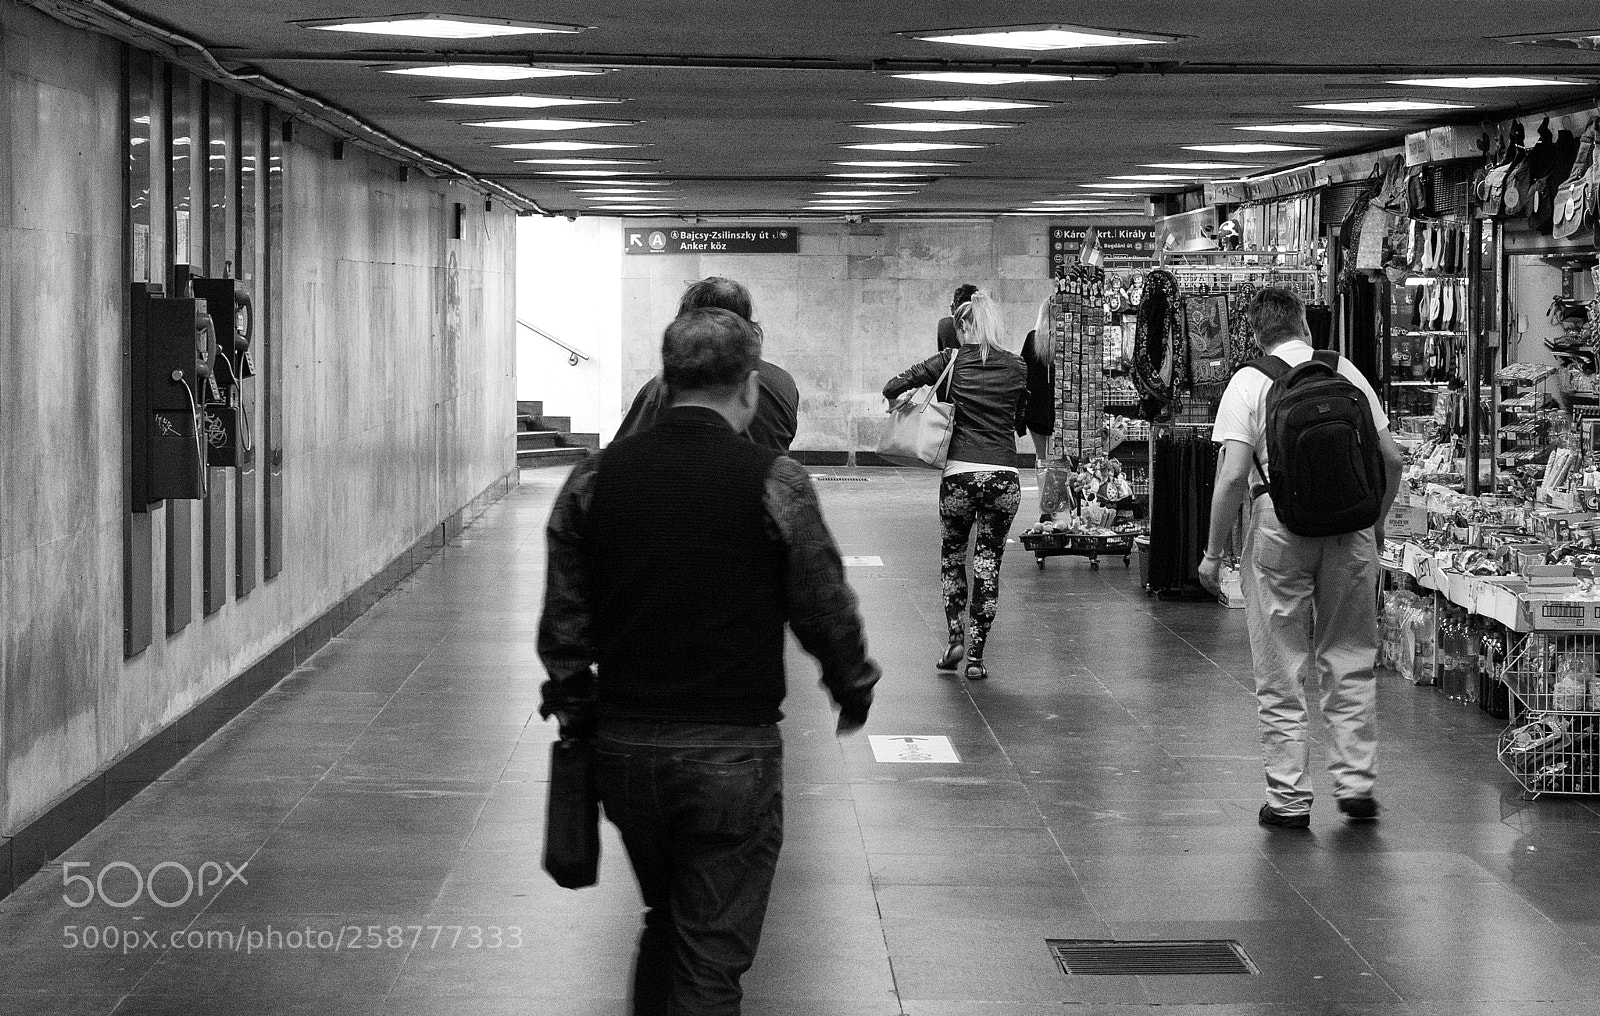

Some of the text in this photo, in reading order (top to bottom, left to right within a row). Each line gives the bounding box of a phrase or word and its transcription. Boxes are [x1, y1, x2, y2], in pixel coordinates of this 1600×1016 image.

[680, 231, 756, 241] Bajcsy-Zsilinszky
[759, 231, 769, 239] út
[1063, 229, 1094, 240] Káro
[1097, 229, 1114, 239] krt.
[1119, 229, 1147, 240] Király
[652, 234, 663, 246] A
[680, 242, 727, 250] Anker köz
